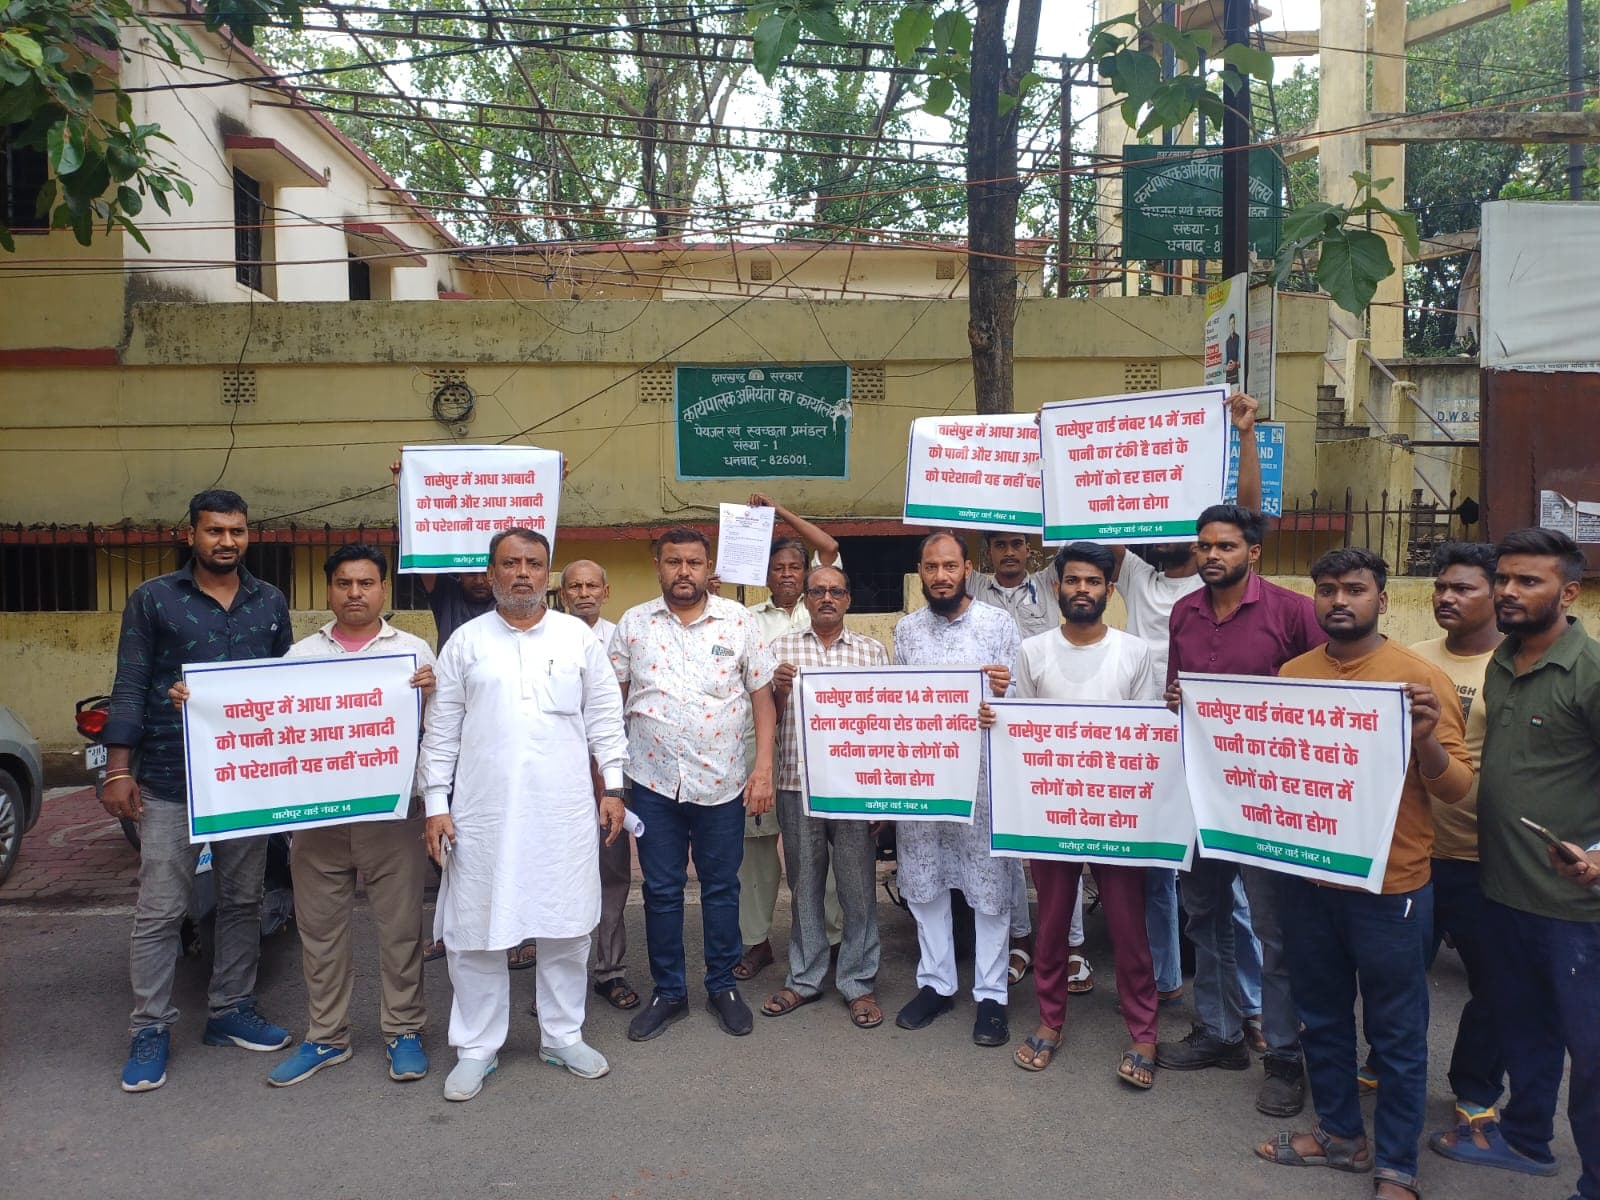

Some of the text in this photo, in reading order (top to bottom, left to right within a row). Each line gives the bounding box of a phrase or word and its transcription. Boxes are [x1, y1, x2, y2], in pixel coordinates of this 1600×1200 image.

[1214, 226, 1219, 235] 1
[770, 372, 804, 383] सरकार
[778, 389, 795, 404] का
[694, 424, 726, 438] पेयजल
[747, 426, 787, 438] स्वच्छता
[790, 423, 828, 438] प्रमंडल
[939, 423, 1015, 440] वासेपुर में आधा
[1056, 408, 1206, 438] वासेपुर वार्ड नंबर 14 में जहां
[733, 439, 778, 451] संख्या 1
[929, 444, 943, 458] को
[945, 446, 969, 460] पानी
[972, 446, 992, 462] और
[994, 451, 1020, 463] आधा
[1069, 438, 1189, 462] पानी का टंकी है वहां के
[424, 471, 535, 489] वासेपुर में आधा आबादी
[925, 468, 1026, 487] को परेशानी यह नहीं
[1075, 465, 1185, 488] लोगों को हर हाल में
[416, 493, 543, 509] को पानी और आधा आबादी
[416, 519, 430, 532] को
[433, 518, 472, 531] परेशानी
[476, 519, 491, 530] यह
[493, 517, 514, 530] नहीं
[815, 687, 852, 707] वासेपुर
[855, 687, 874, 703] वार्ड
[876, 688, 903, 703] नंबर
[905, 690, 919, 703] 14
[936, 690, 969, 703] लाला
[1454, 684, 1477, 696] IGH
[224, 688, 383, 721] वासेपुर में आधा आबादी
[1196, 698, 1379, 731] वासेपुर वार्ड नंबर 14 में जहां
[215, 717, 395, 750] को पानी और आधा आबादी
[810, 714, 977, 735] टोला मटकुरिया रोड कली मंदिर
[1008, 720, 1179, 743] वासेपुर वार्ड नंबर 14 में जहां
[829, 741, 960, 759] मदीना नगर के लोगों को
[1213, 733, 1359, 766] पानी का टंकी है वहां के
[215, 746, 399, 782] को परेशानी यह नहीं चलेगी
[1023, 749, 1160, 770] पानी का टंकी है वहां के
[855, 769, 935, 786] पानी देना होगा
[1030, 778, 1154, 799] लोगों को हर हाल में
[1242, 804, 1338, 835] पानी देना होगा
